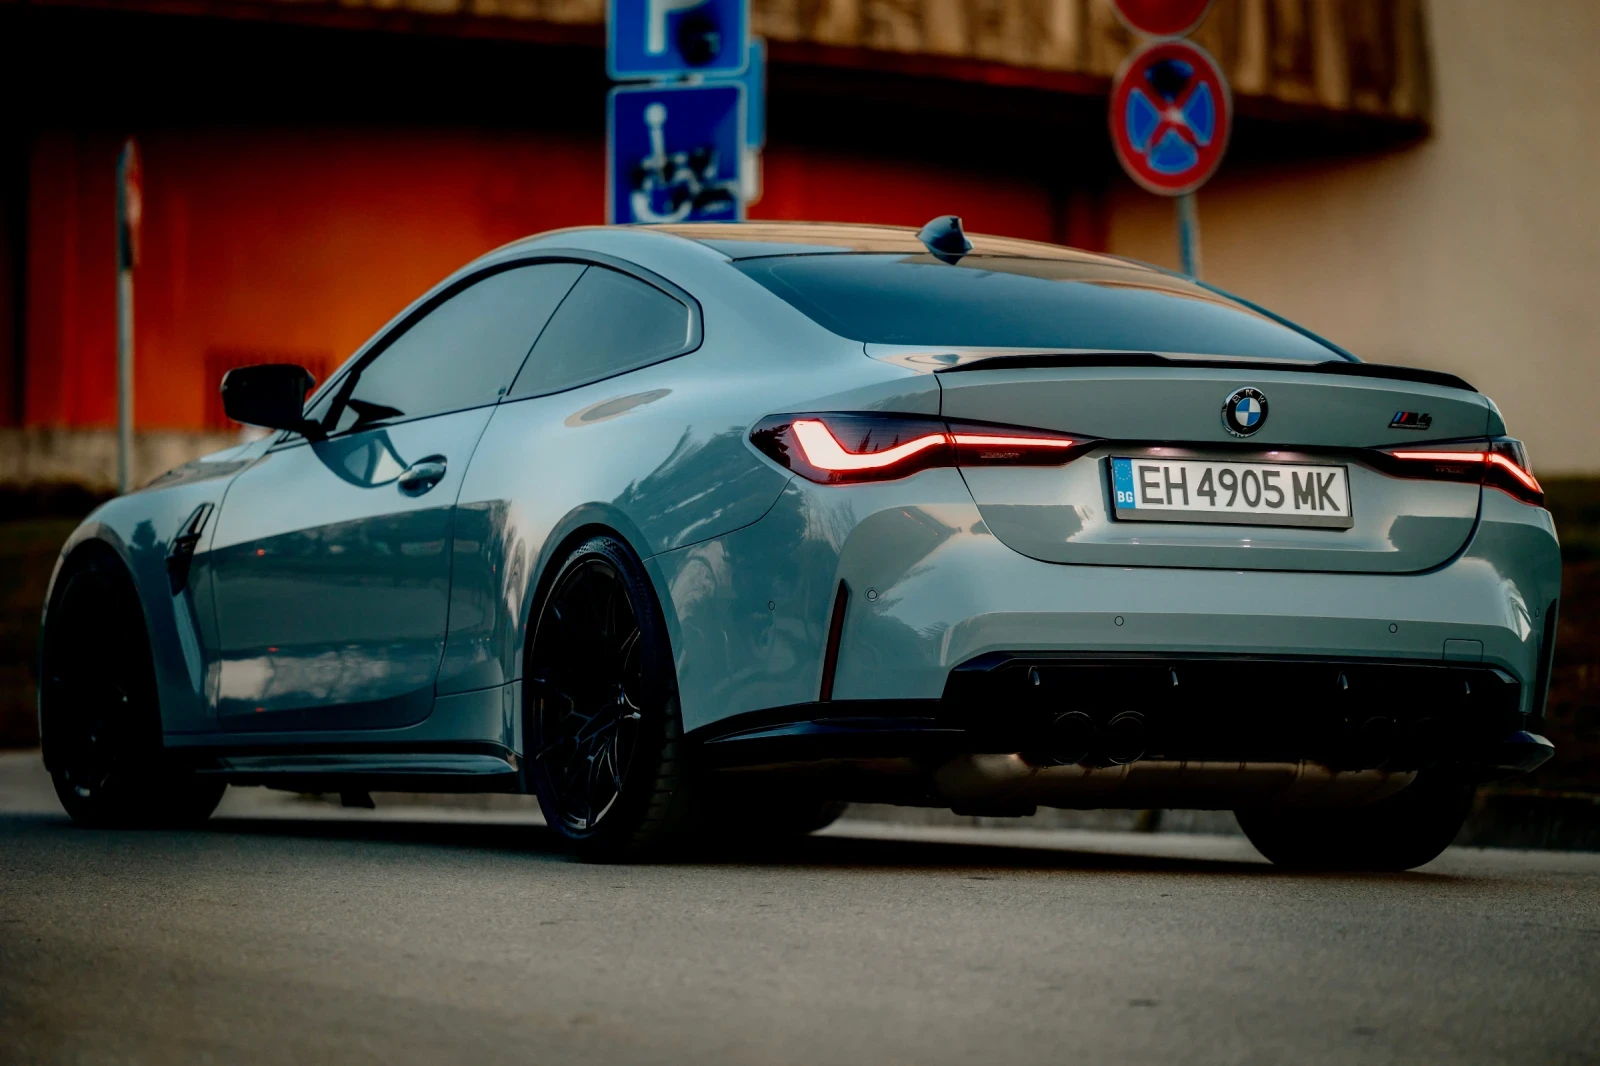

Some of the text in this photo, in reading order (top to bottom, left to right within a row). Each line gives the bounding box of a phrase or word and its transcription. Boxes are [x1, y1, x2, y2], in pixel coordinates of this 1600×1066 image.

[1117, 491, 1134, 503] BG
[1138, 465, 1341, 512] EH 4905 MK
